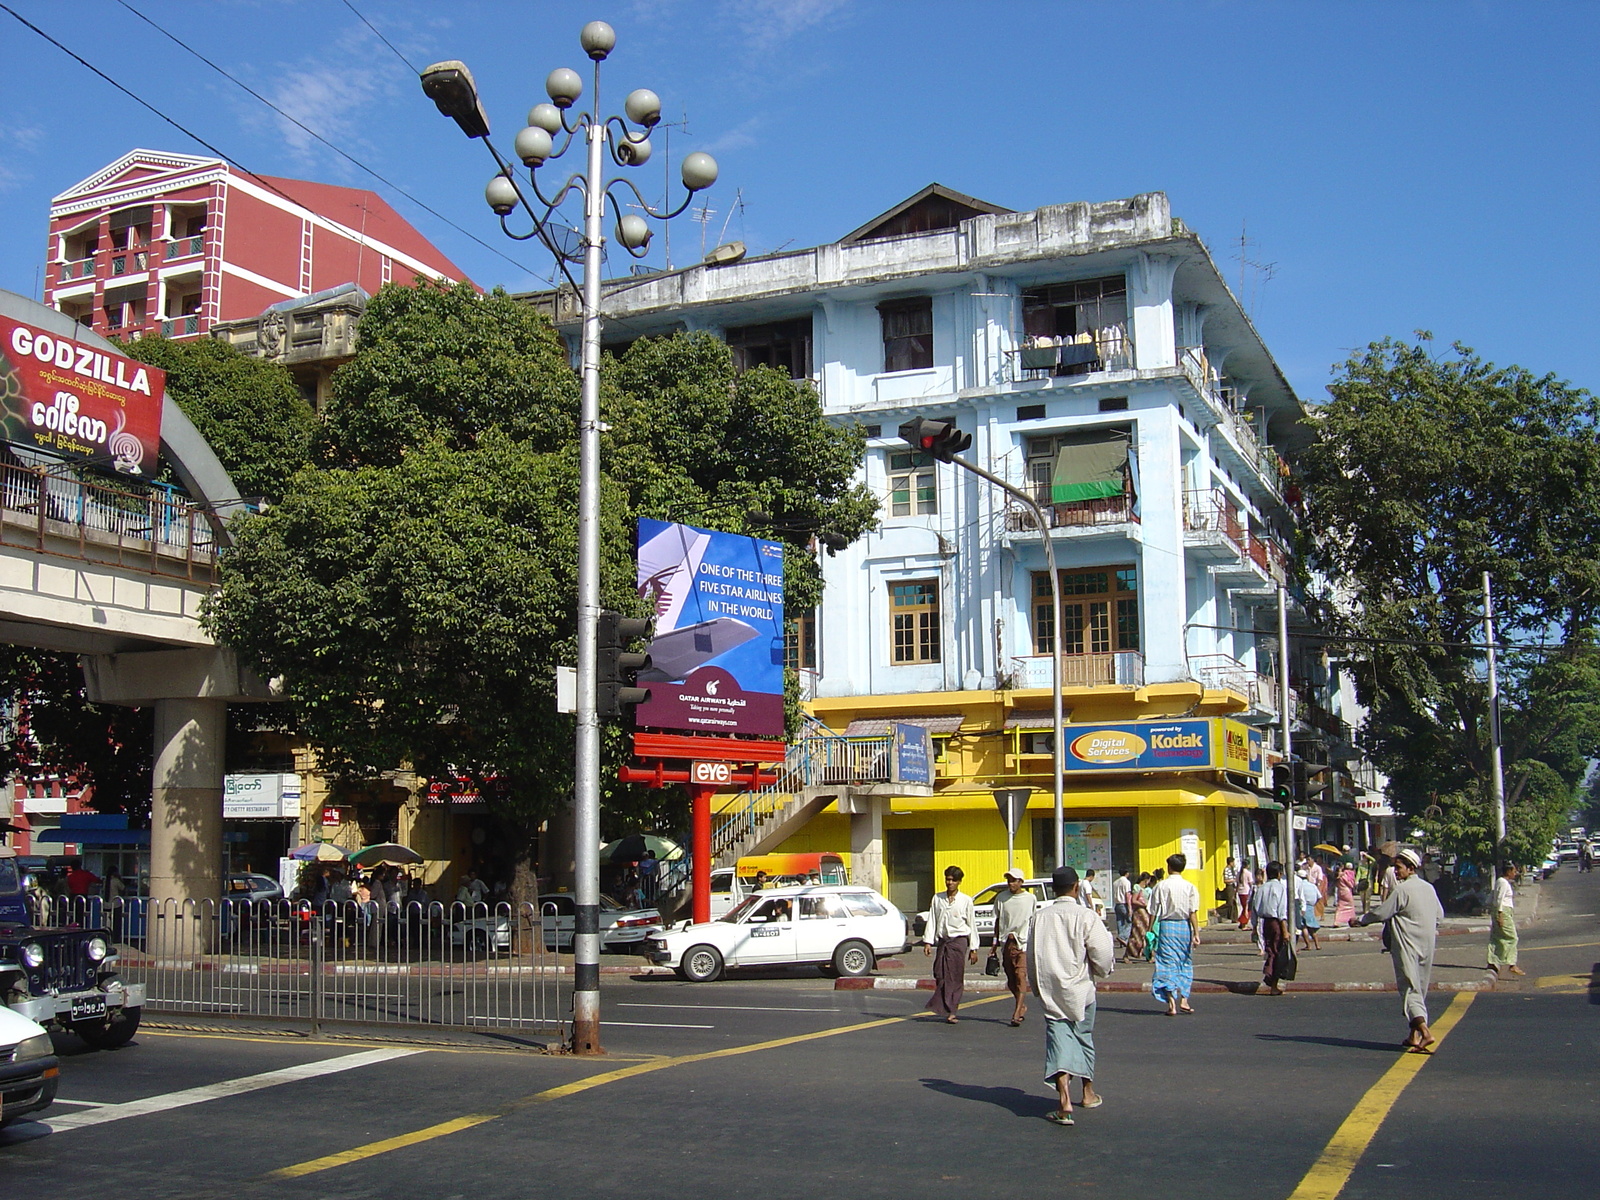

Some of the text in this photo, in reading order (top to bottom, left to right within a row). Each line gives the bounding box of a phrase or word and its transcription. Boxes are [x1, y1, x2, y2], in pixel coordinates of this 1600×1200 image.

[12, 327, 151, 396] GODZILLA
[700, 562, 782, 587] ONE OF THE THREE
[700, 580, 782, 604] FIVE STAR AIRLINES
[708, 599, 774, 620] IN THE WORLD
[679, 694, 726, 705] QATAR AIRWAYS
[1174, 725, 1182, 733] by
[1091, 737, 1126, 749] Digital
[1151, 733, 1204, 749] Kodak
[1087, 747, 1130, 757] Services
[1152, 748, 1205, 759] Technology
